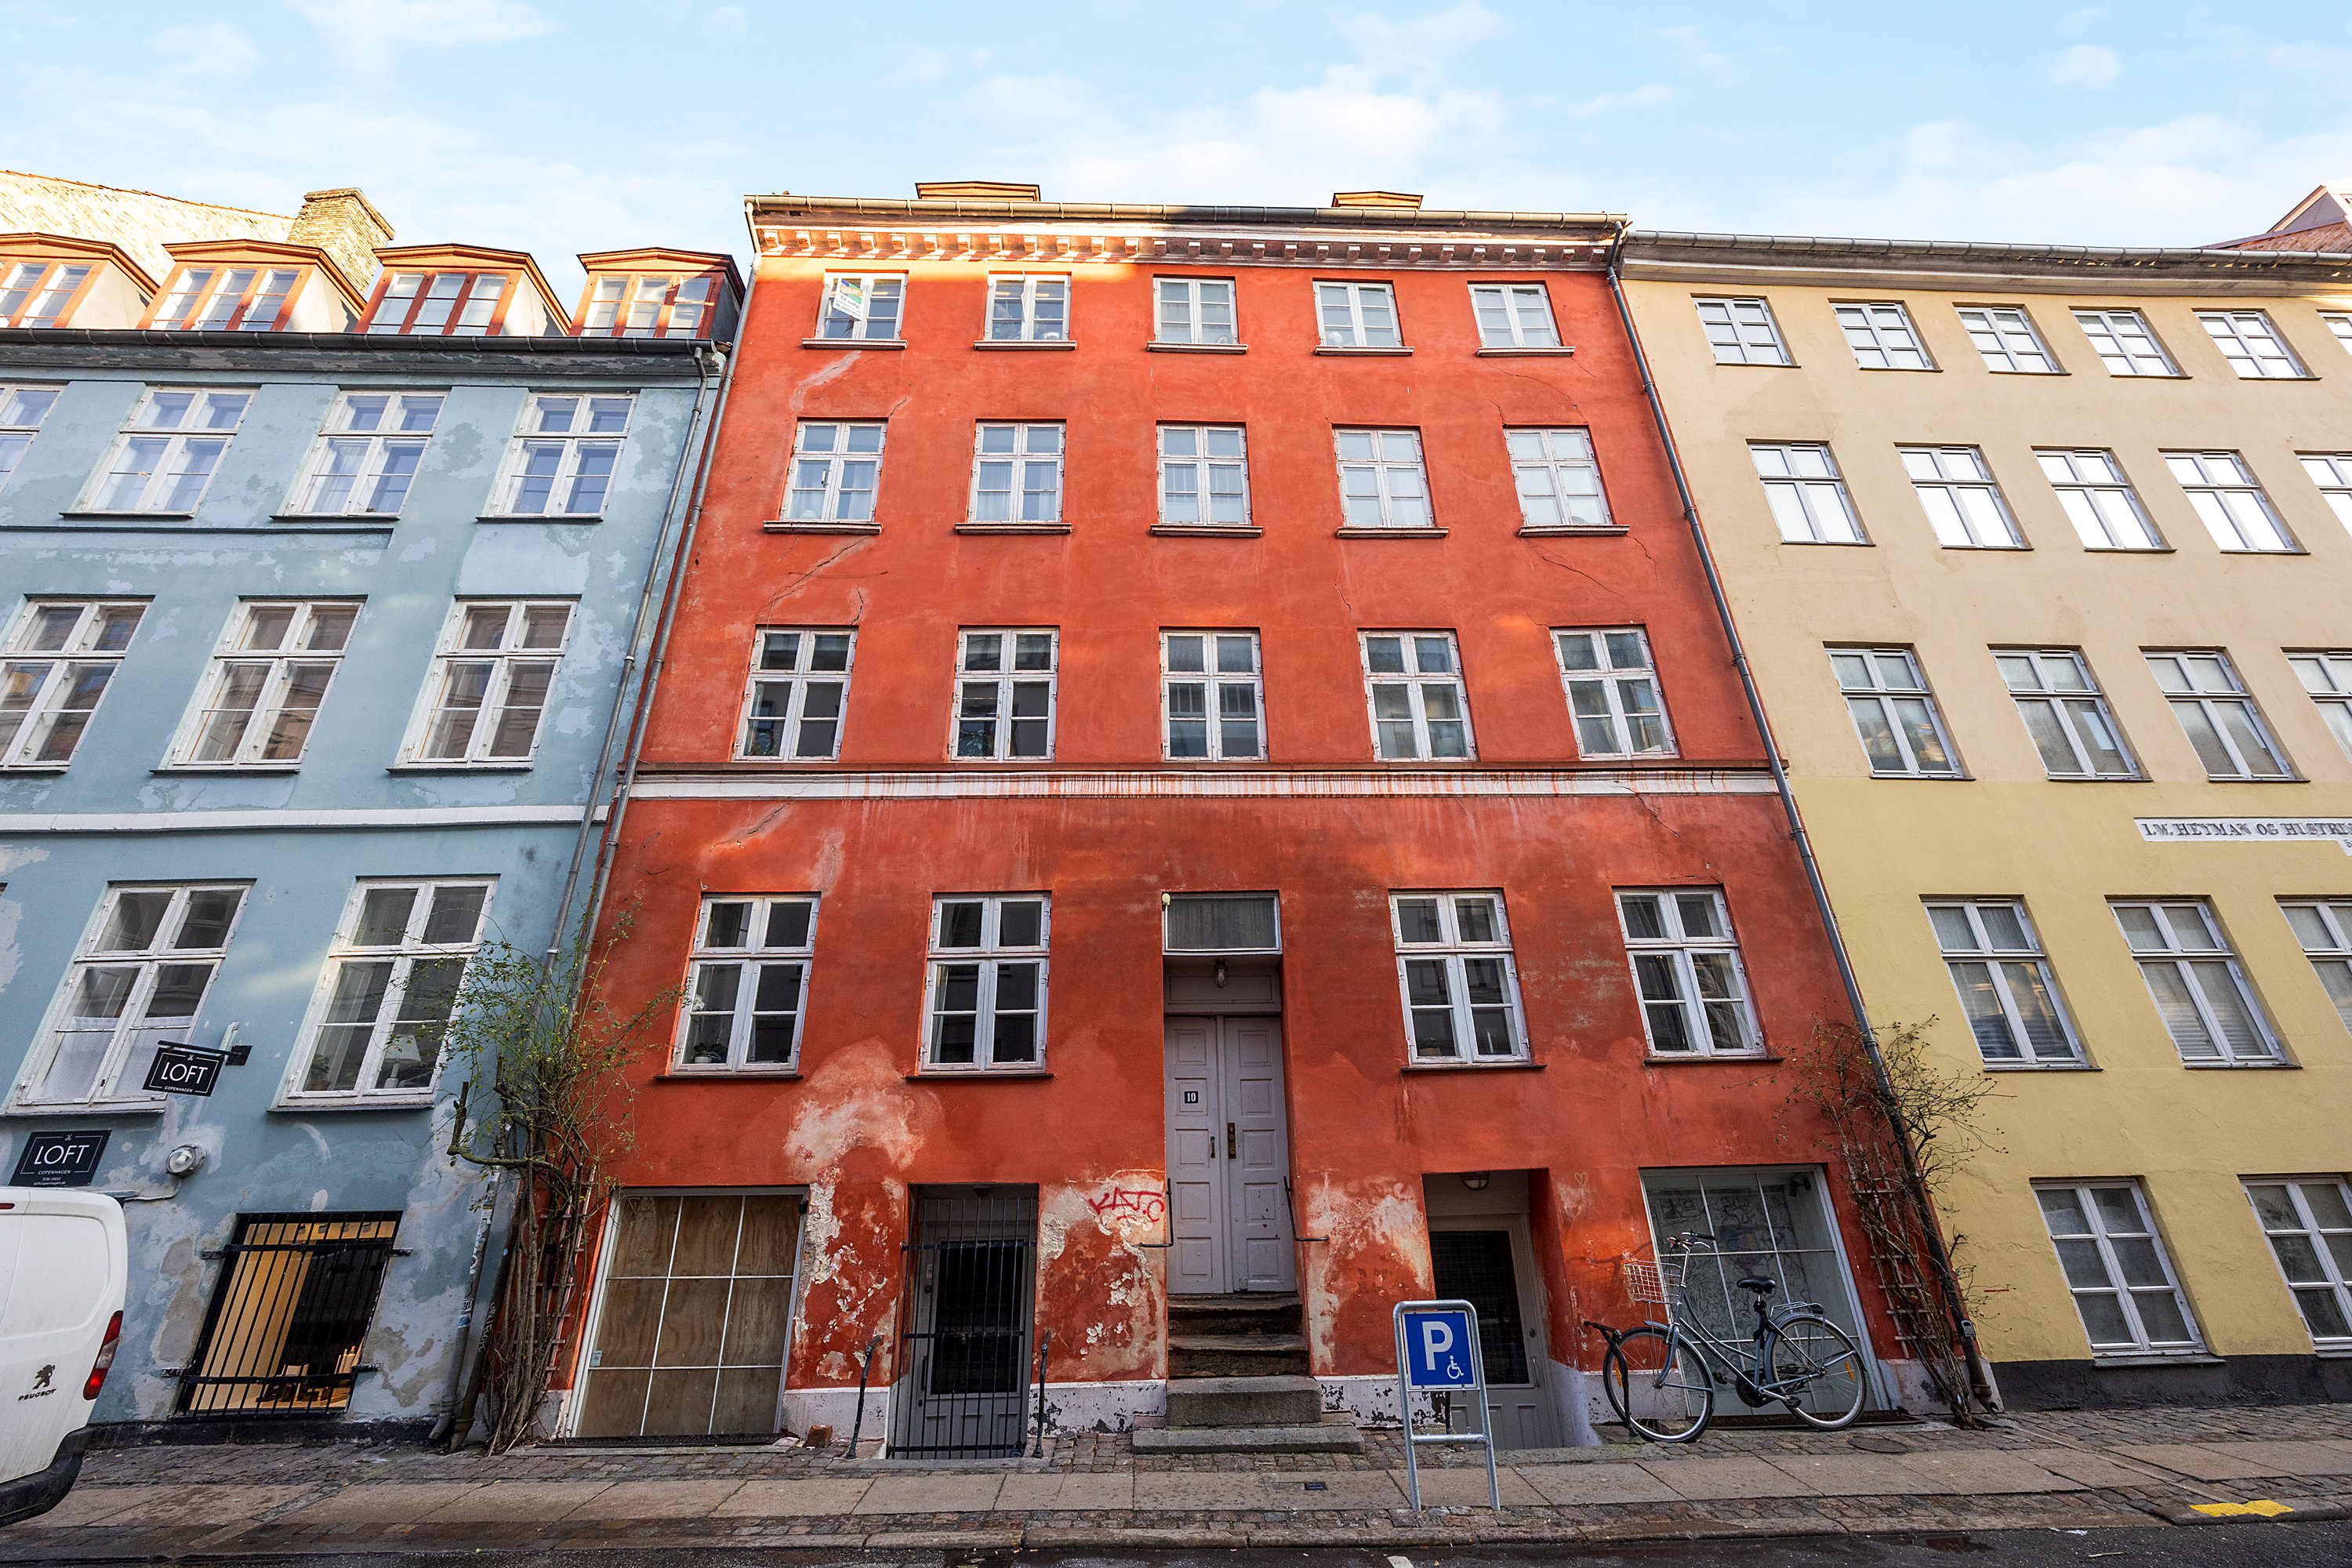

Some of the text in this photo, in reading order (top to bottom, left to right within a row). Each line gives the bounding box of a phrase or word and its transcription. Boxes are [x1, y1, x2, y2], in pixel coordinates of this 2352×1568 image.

[2256, 823, 2278, 836] OG
[161, 1062, 209, 1083] LOFT
[1187, 1092, 1196, 1102] 10
[34, 1145, 90, 1165] LOFT
[1421, 1320, 1454, 1370] P
[18, 1388, 56, 1401] PEUGEOT
